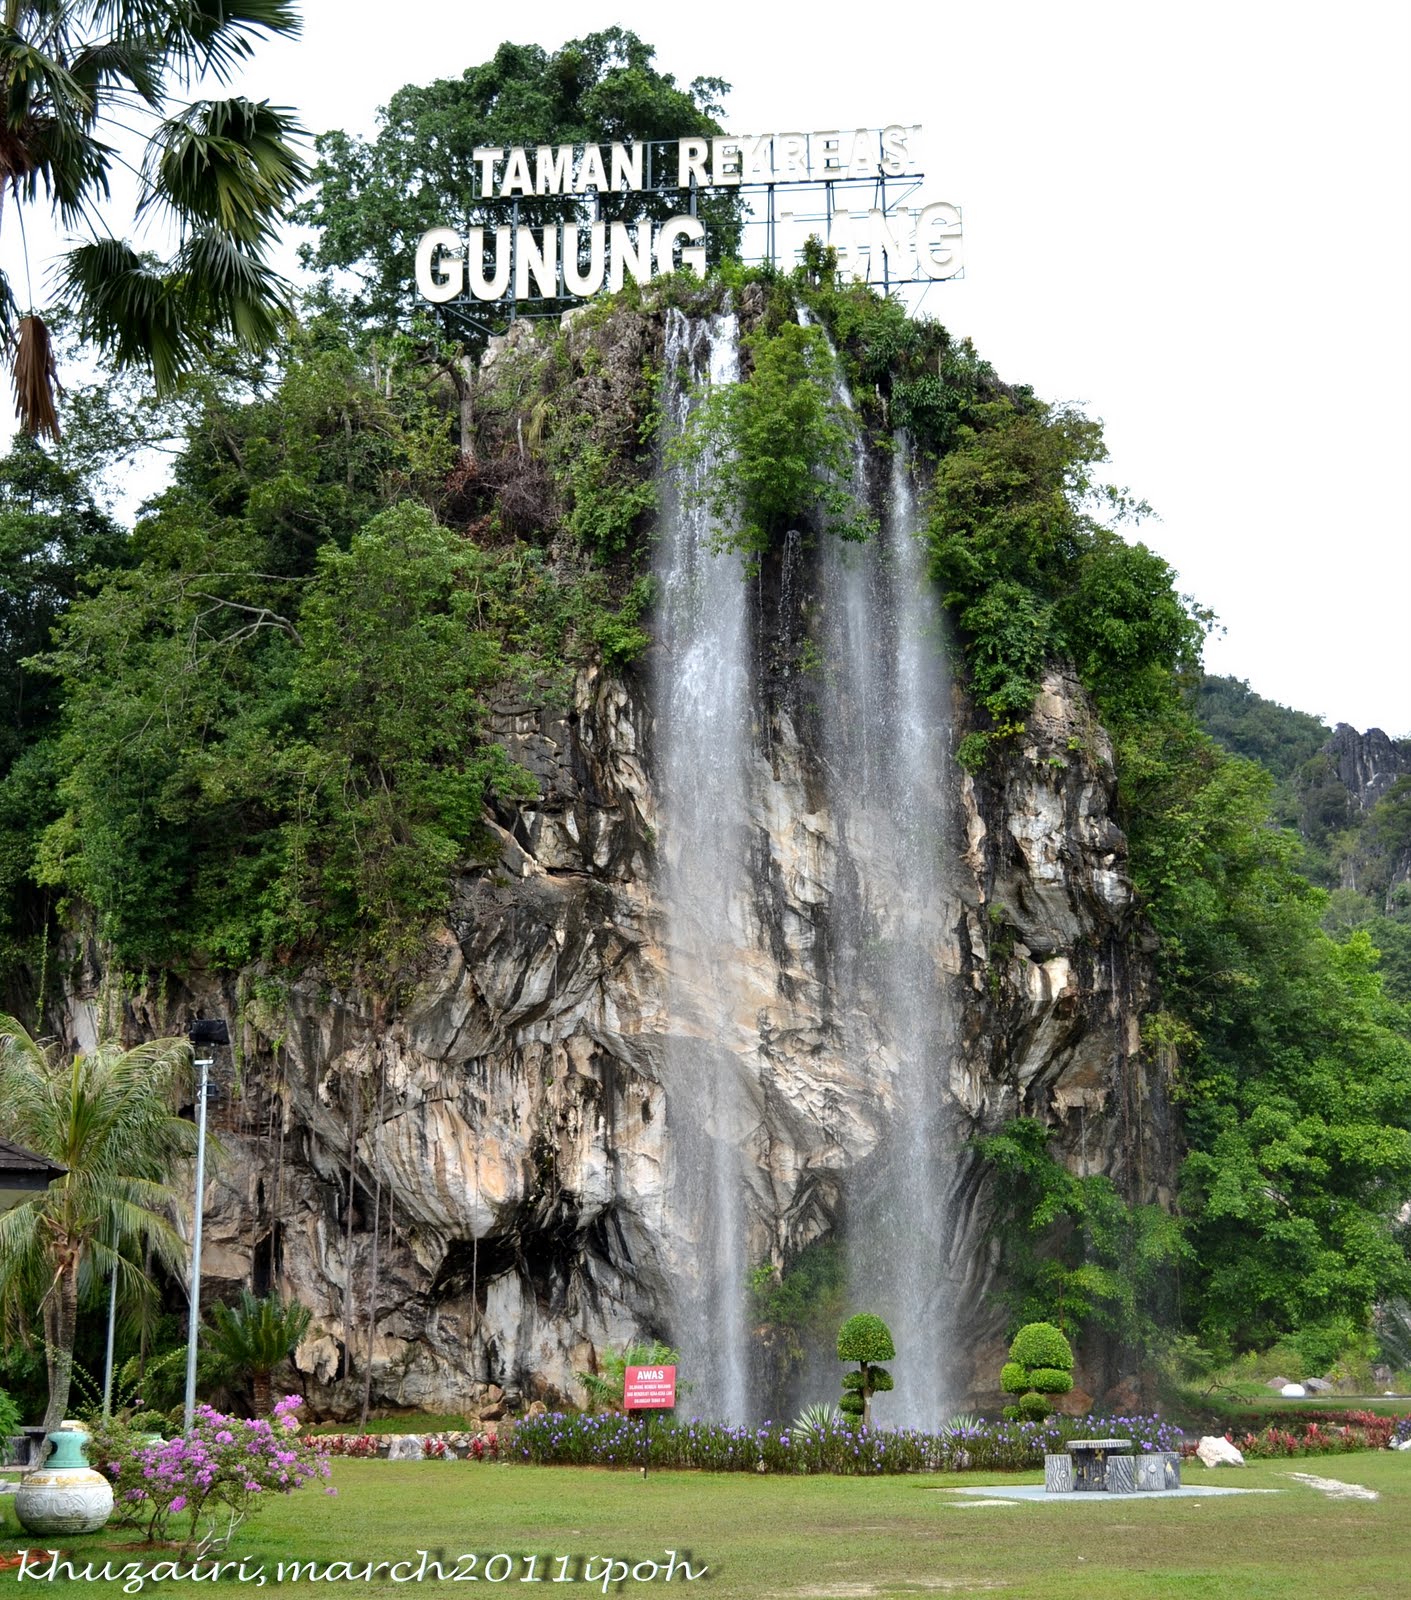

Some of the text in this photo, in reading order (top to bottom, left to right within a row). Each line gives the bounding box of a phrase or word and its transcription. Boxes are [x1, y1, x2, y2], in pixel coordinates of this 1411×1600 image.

[473, 140, 643, 198] TAMAN
[415, 214, 706, 303] GUNUNG
[637, 1370, 664, 1380] AWAS
